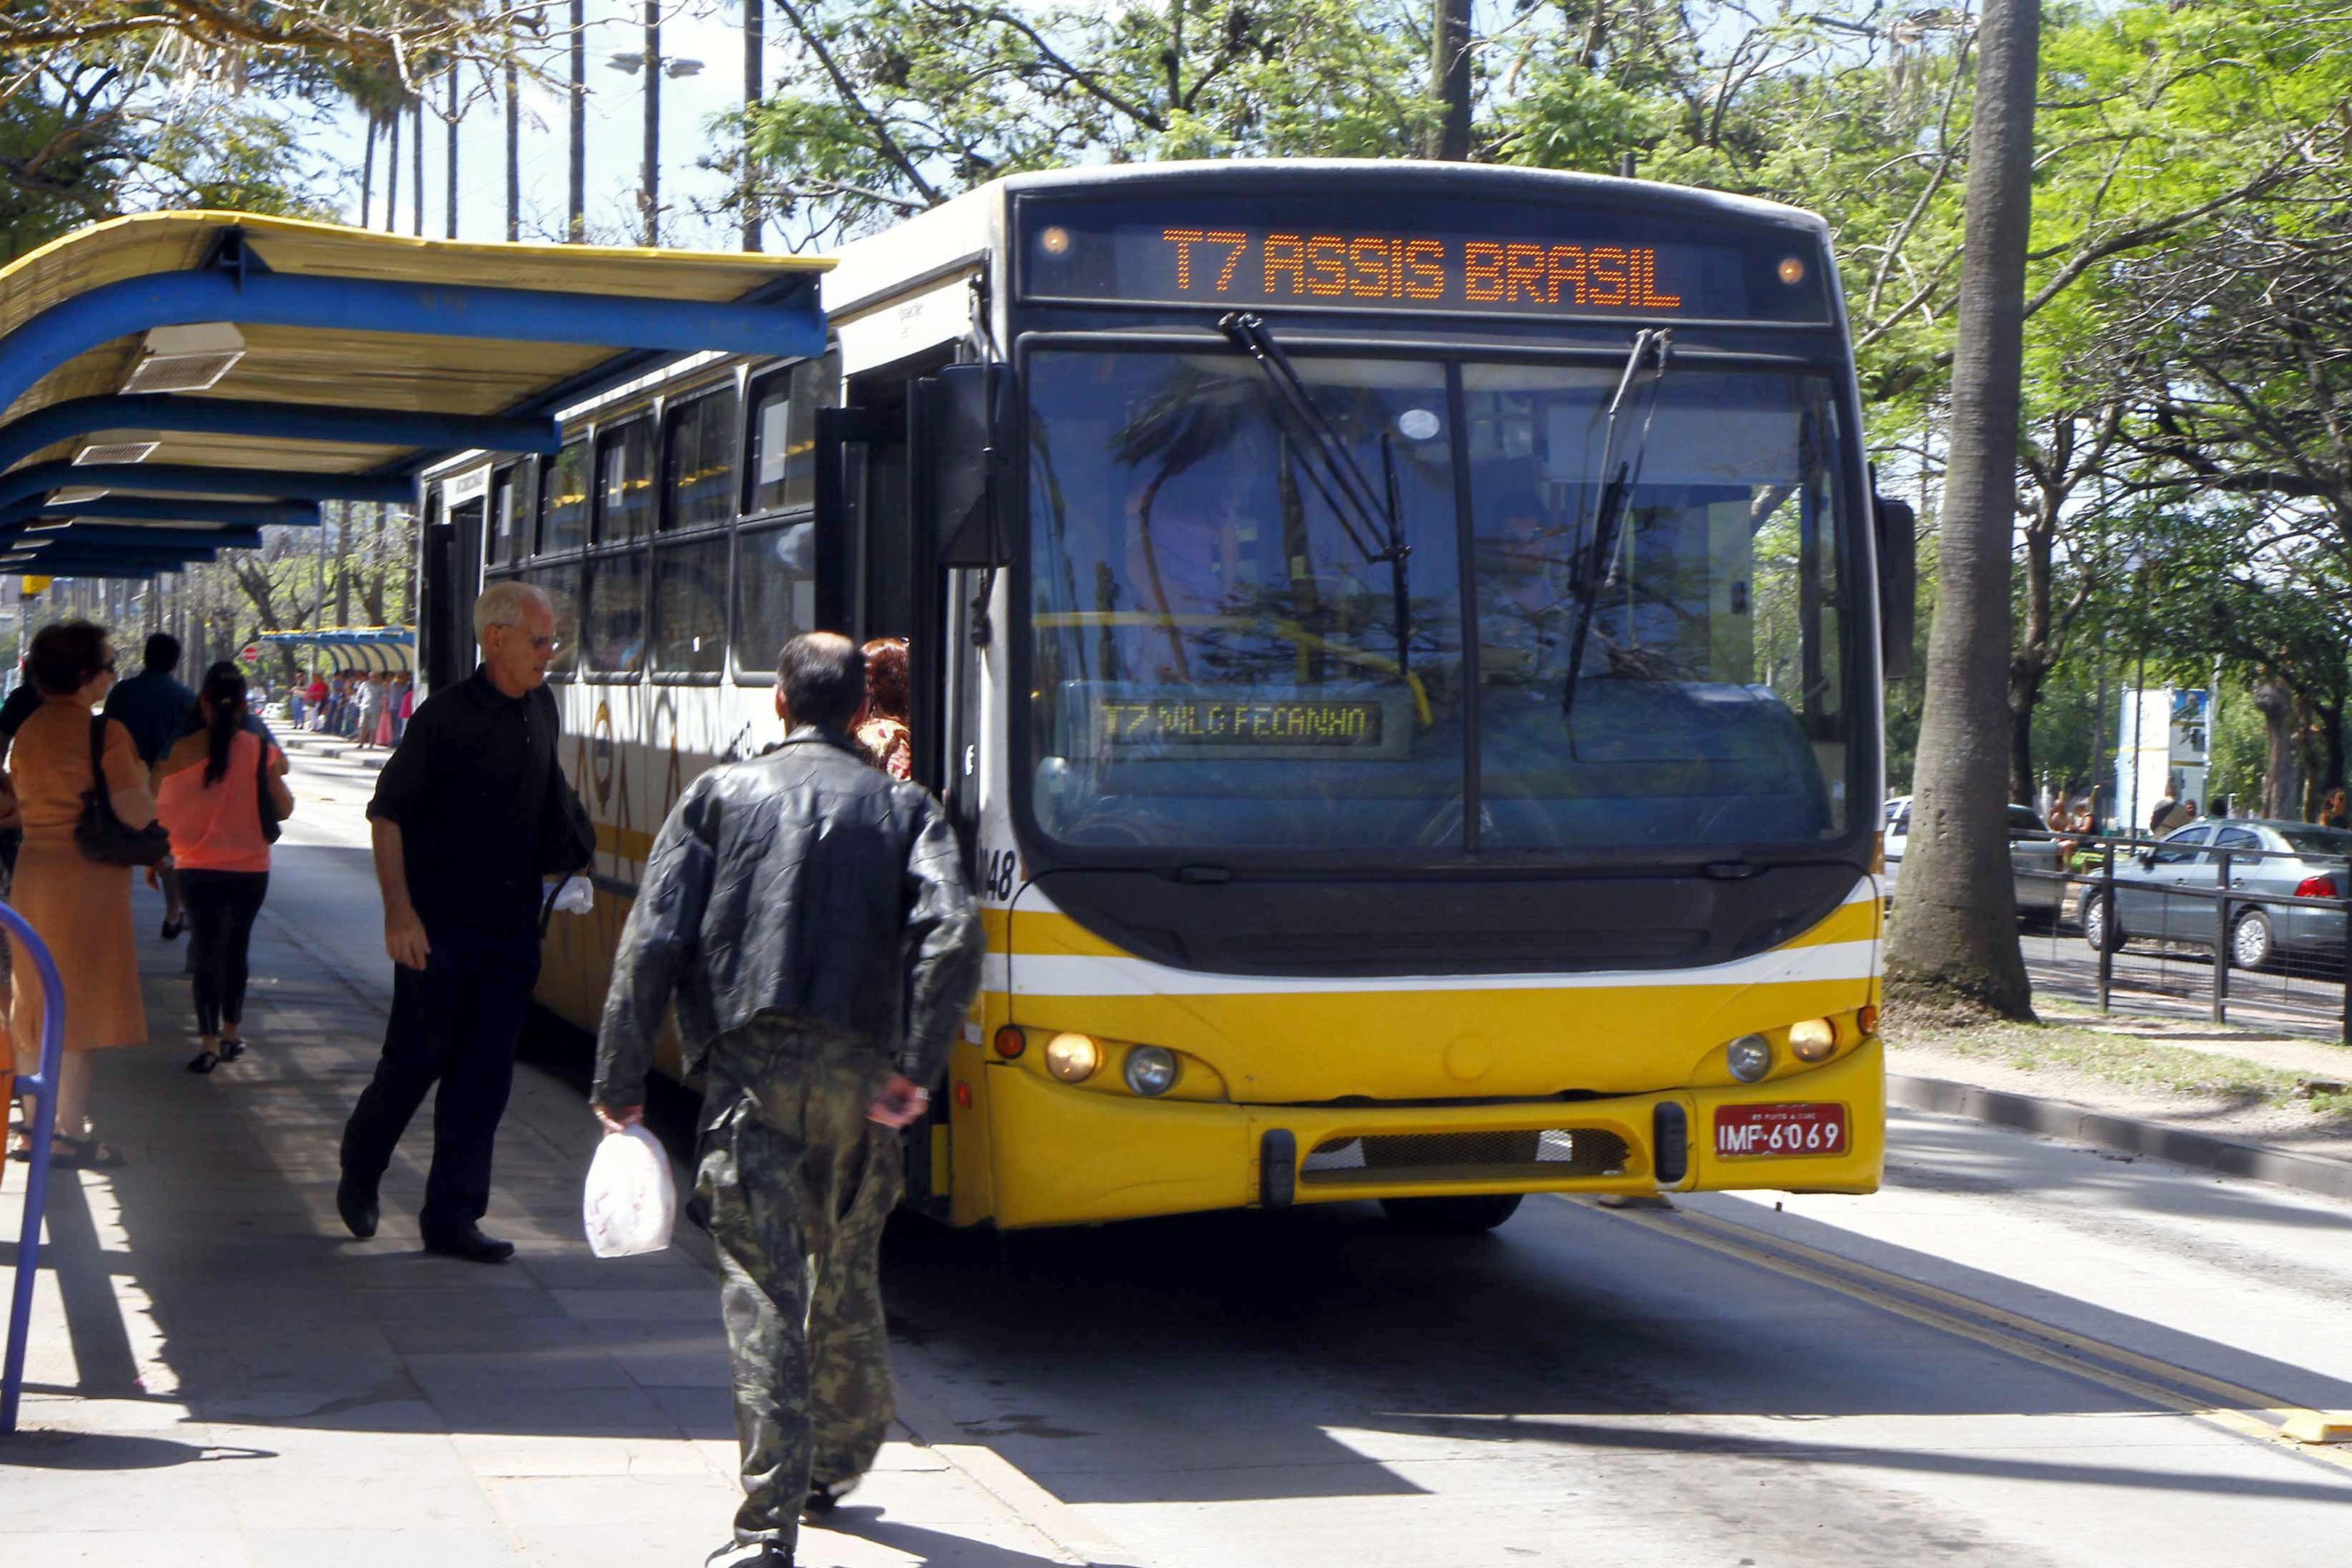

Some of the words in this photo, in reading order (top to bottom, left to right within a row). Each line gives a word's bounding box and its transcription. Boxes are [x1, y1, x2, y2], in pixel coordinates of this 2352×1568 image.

[1163, 229, 1247, 291] T7
[1264, 233, 1446, 300] ASSIS
[1465, 240, 1682, 309] BRASIL
[1102, 705, 1151, 734] T7
